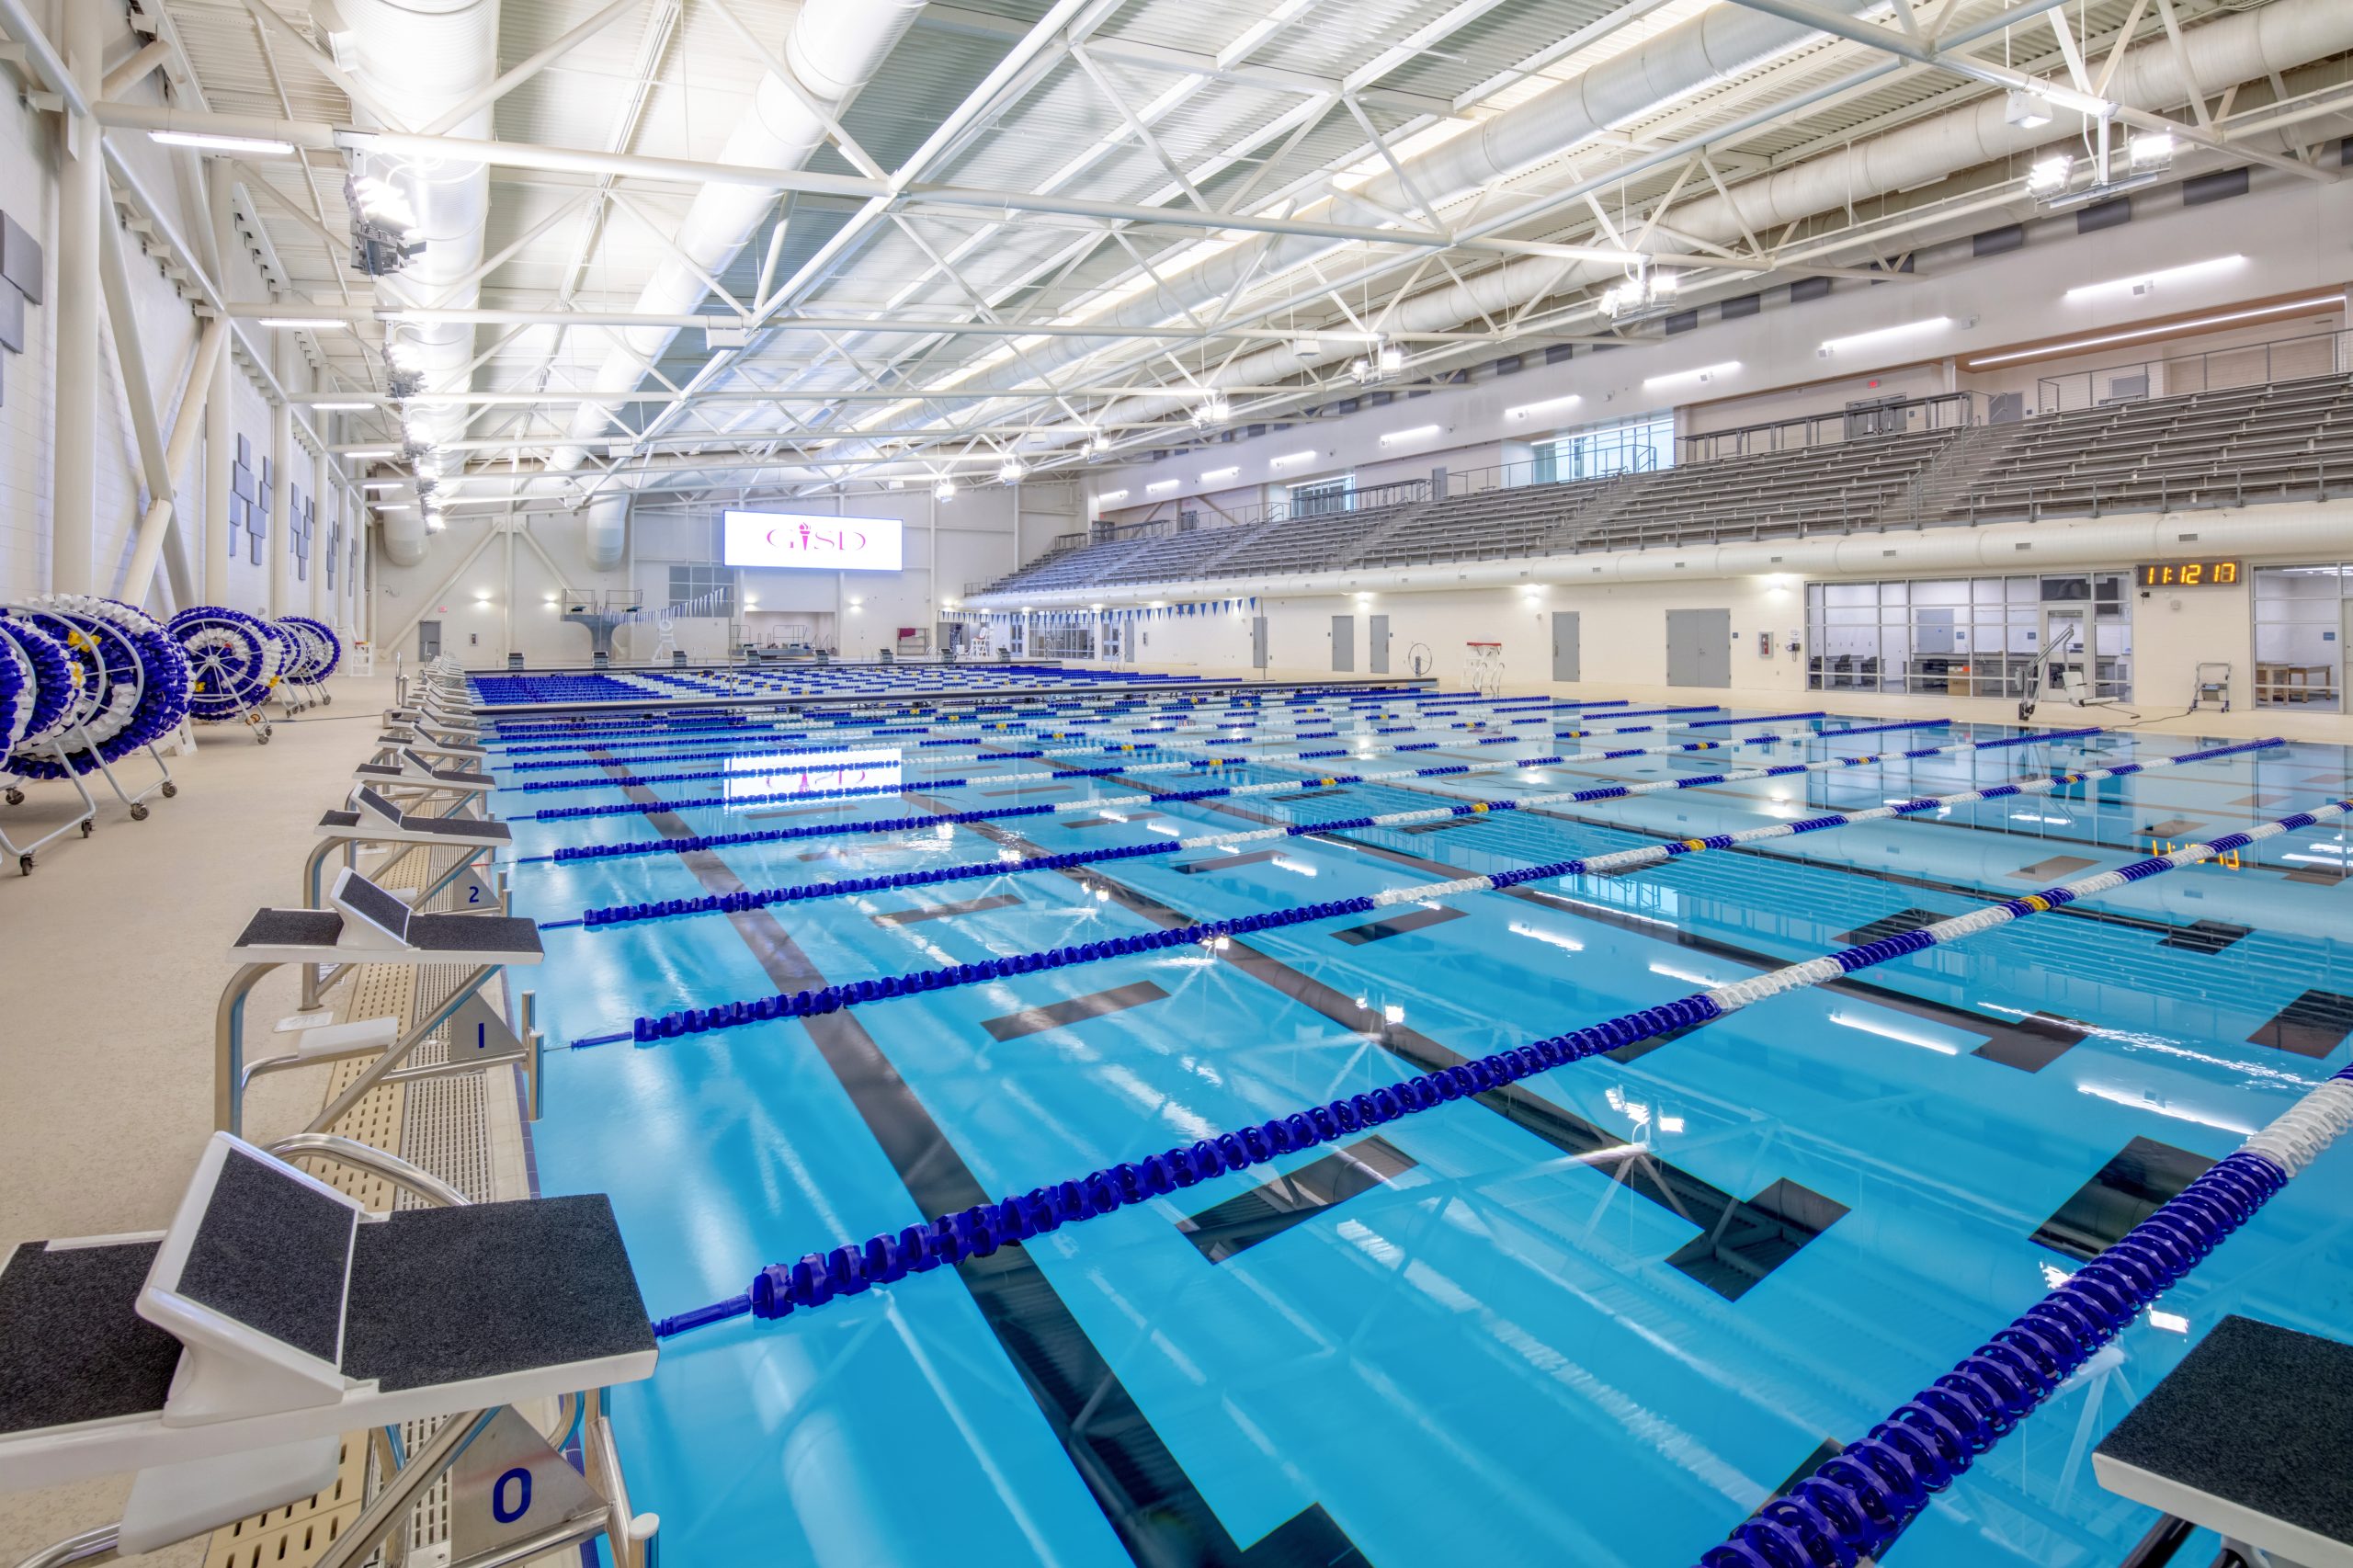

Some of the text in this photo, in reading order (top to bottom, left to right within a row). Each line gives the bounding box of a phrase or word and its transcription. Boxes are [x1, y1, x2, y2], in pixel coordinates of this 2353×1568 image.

[2147, 562, 2235, 585] 11:12 17
[469, 886, 480, 903] 2
[478, 1022, 484, 1049] 1
[493, 1467, 532, 1524] 0
